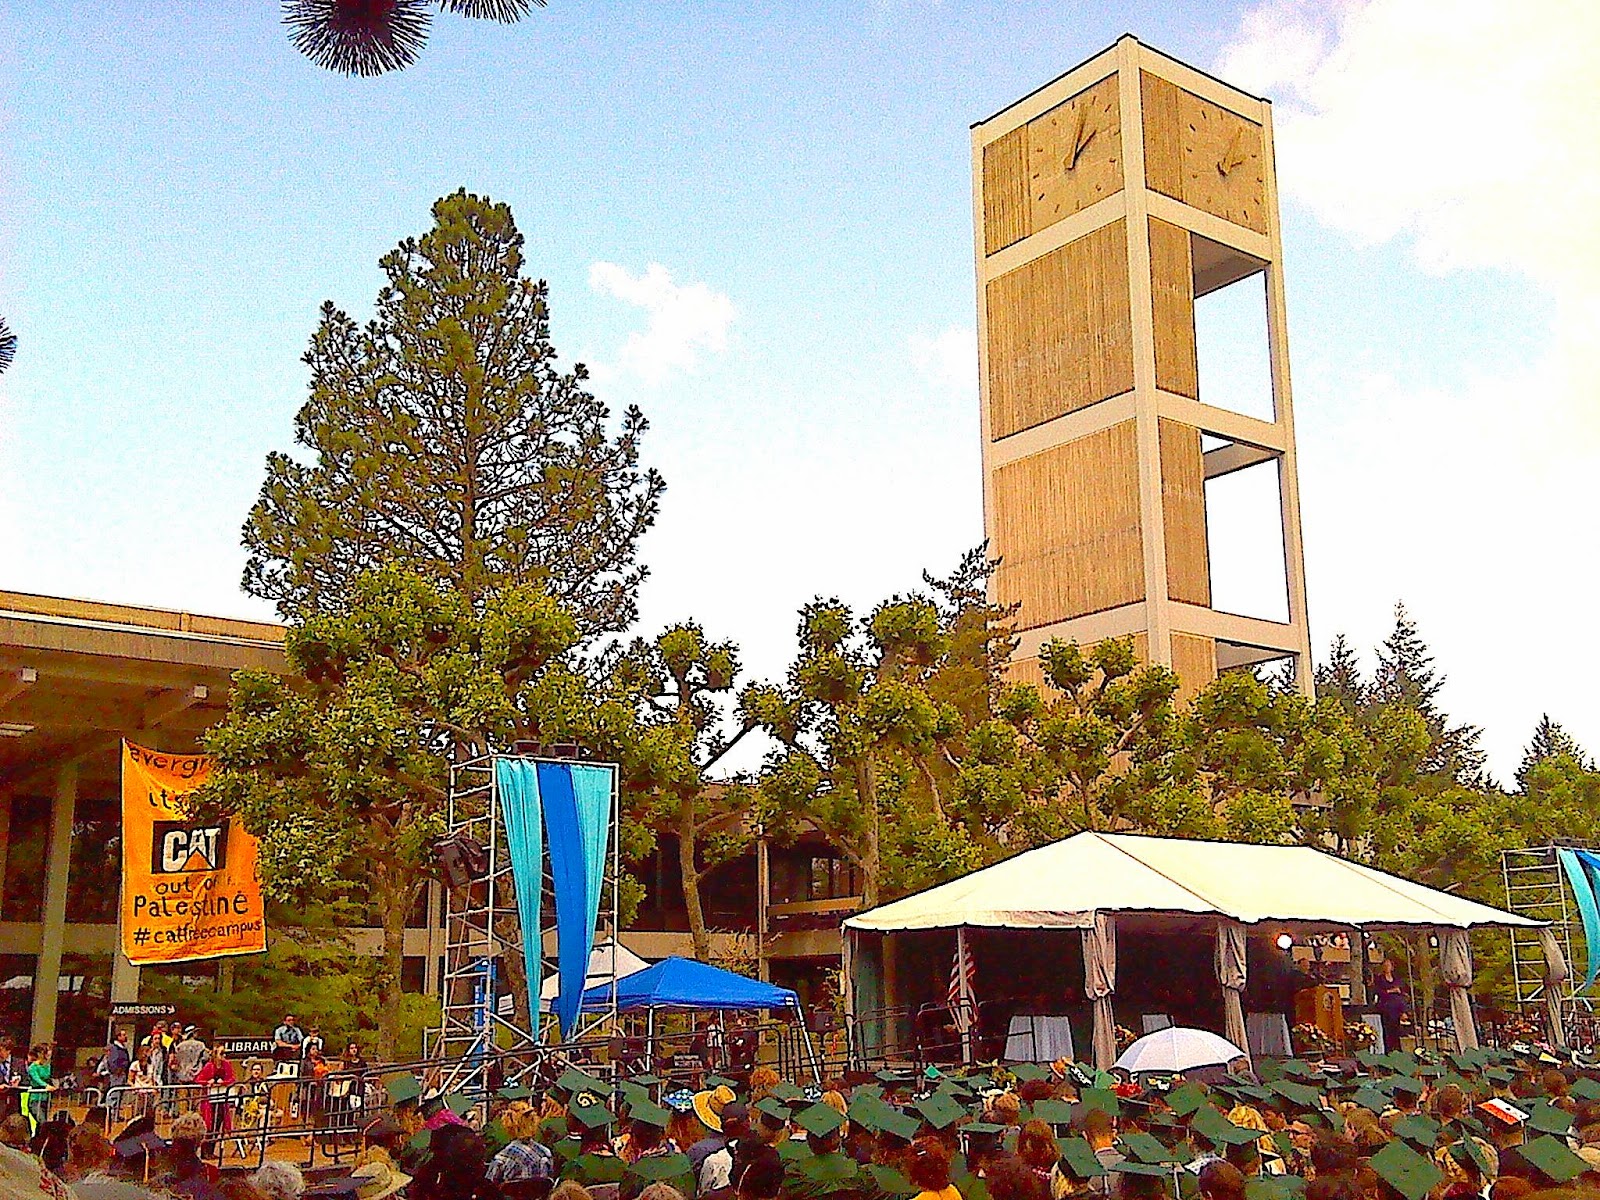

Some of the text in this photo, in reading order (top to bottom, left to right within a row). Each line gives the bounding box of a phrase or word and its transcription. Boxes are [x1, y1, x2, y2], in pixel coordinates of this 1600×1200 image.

[163, 828, 221, 872] CAT
[155, 876, 193, 895] out
[134, 893, 249, 917] Palestine
[133, 920, 262, 947] #catfreecampus
[112, 1005, 167, 1015] ADMISSIONS
[224, 1041, 277, 1053] LIBRARY
